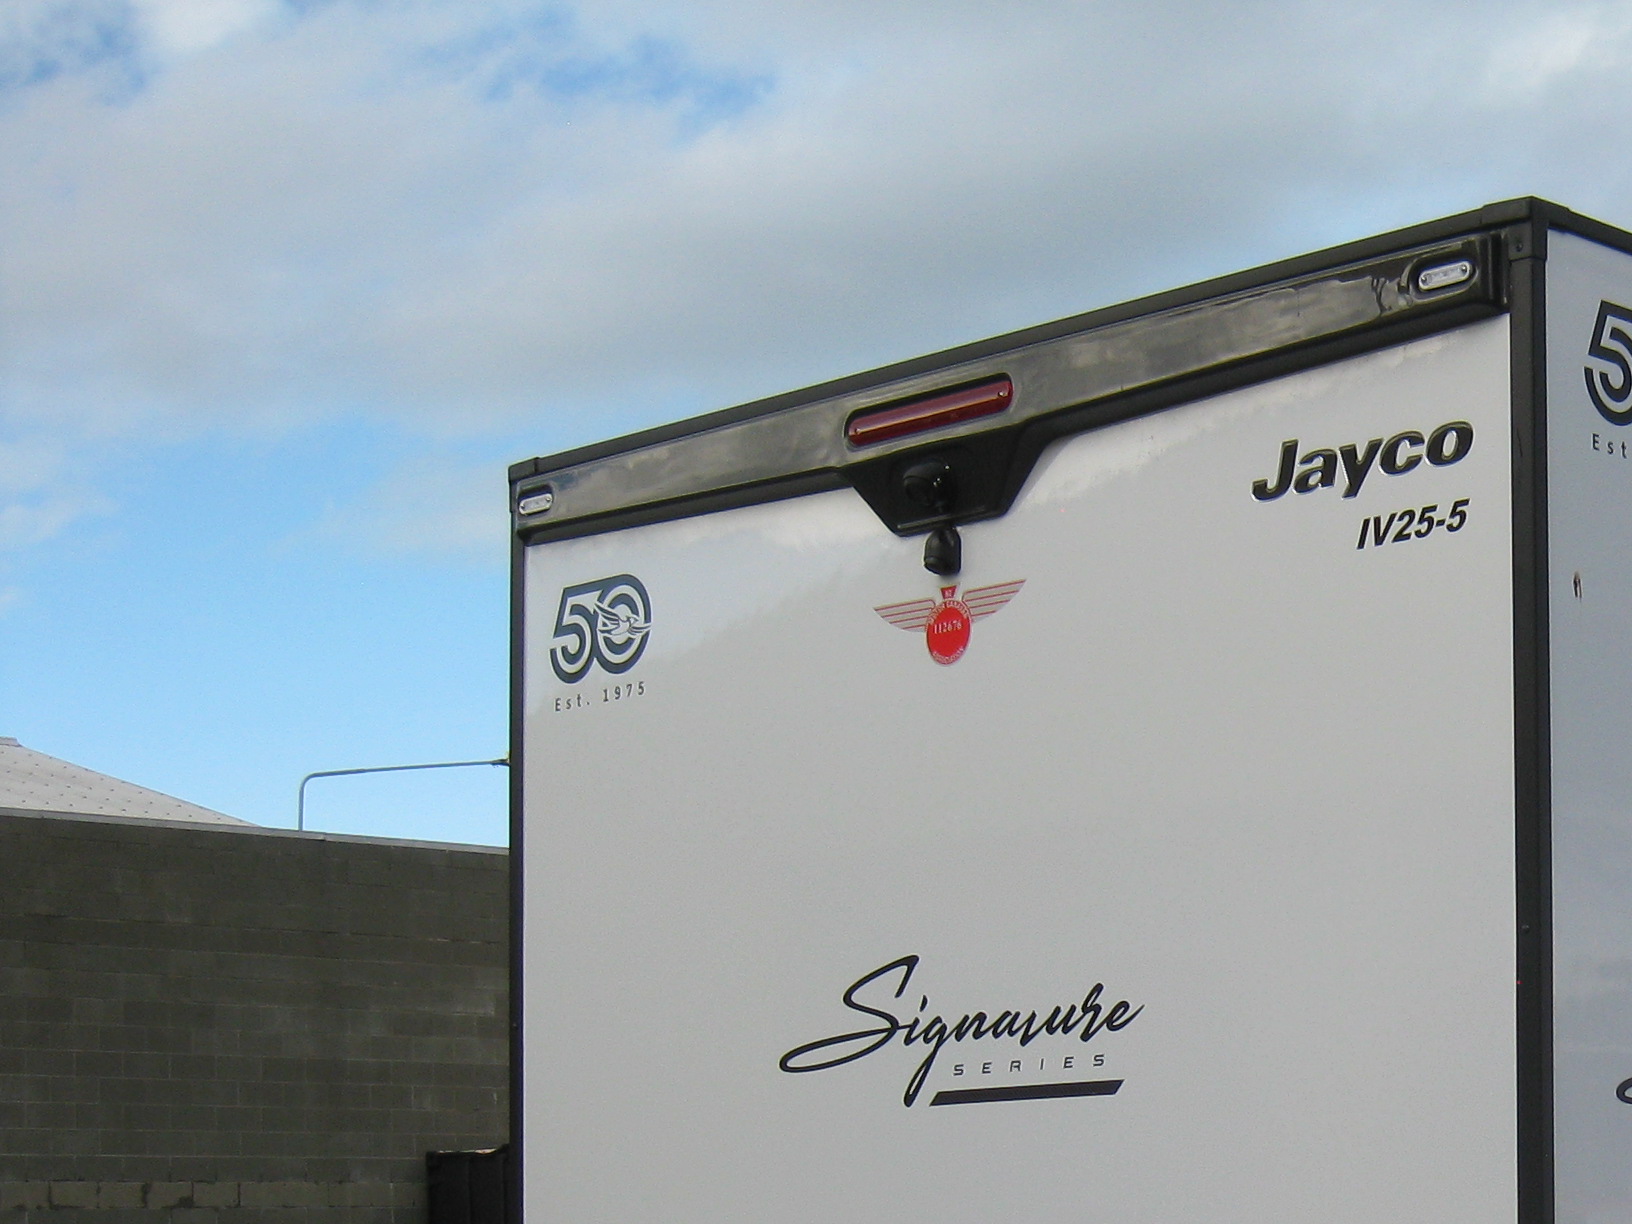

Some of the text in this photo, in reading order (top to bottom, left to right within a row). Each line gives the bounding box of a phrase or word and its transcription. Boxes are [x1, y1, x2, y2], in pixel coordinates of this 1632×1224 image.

[1251, 420, 1474, 502] Jayco
[1356, 498, 1471, 550] IV25-5
[554, 681, 645, 712] Est. 1975
[953, 1053, 1106, 1077] SERIES
